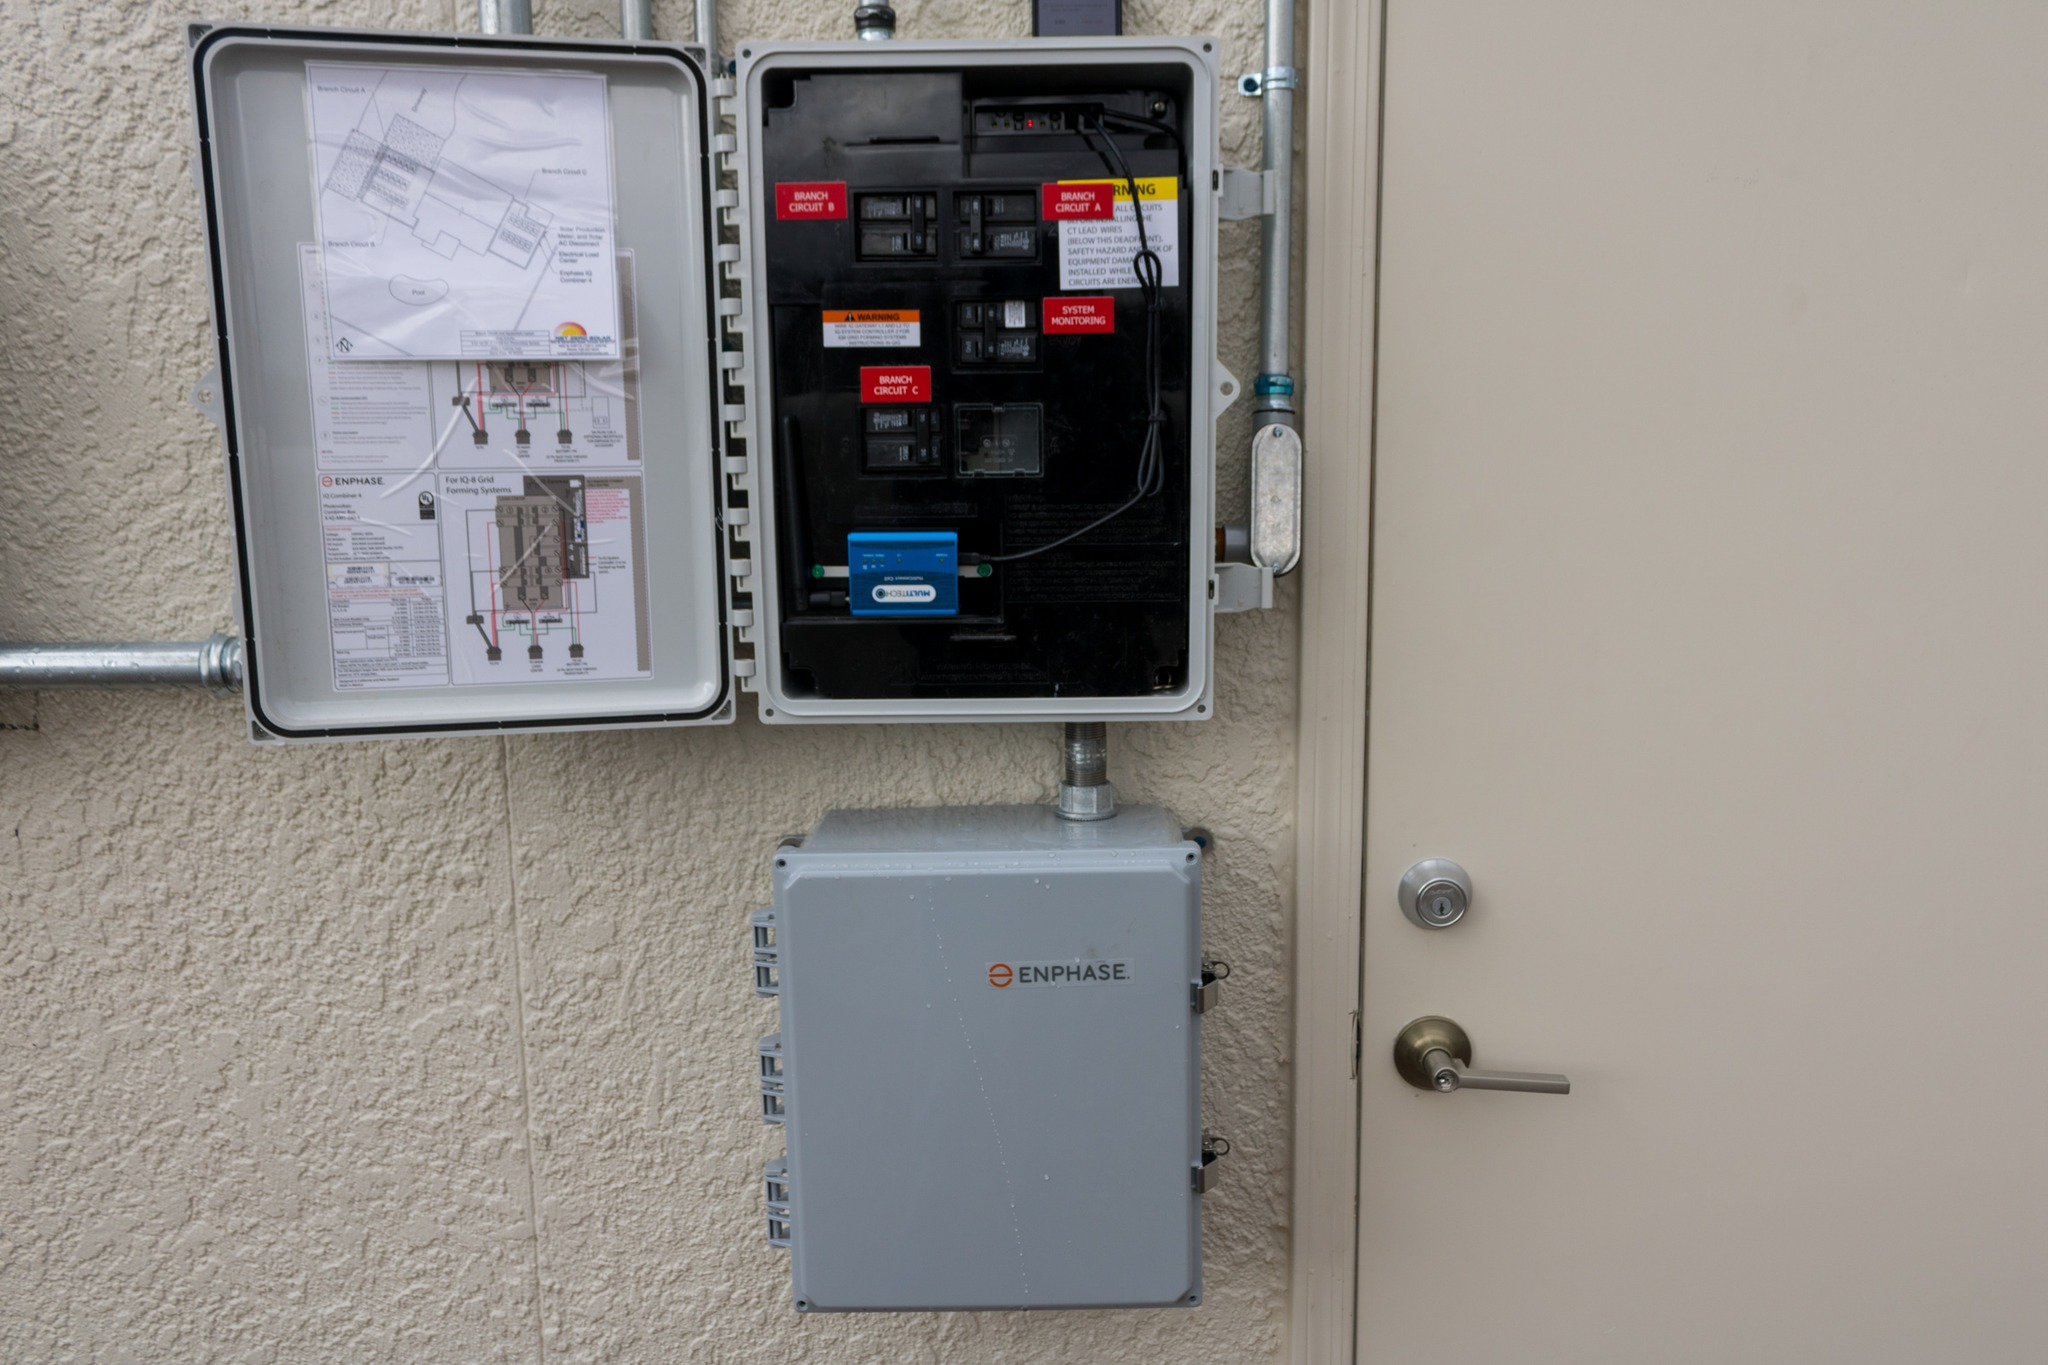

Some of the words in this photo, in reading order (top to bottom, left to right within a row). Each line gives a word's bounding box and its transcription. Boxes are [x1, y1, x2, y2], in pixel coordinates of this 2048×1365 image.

[794, 191, 828, 201] BRANCH
[1061, 192, 1095, 201] BRANCH
[789, 202, 823, 212] CIRCUIT
[828, 202, 835, 212] B
[1055, 203, 1090, 213] CIRCUIT
[1095, 203, 1102, 212] A
[1115, 204, 1129, 212] ALL
[1067, 227, 1076, 235] CT
[1079, 226, 1098, 234] LEAD
[1100, 225, 1122, 234] WIRES
[328, 240, 350, 248] Branch
[1096, 236, 1113, 245] THIS
[1068, 246, 1095, 256] SAFETY
[1096, 246, 1127, 255] HAZARD
[1162, 244, 1173, 252] OF
[1068, 256, 1111, 266] EQUIPMENT
[1068, 267, 1107, 276] INSTALLED
[1109, 266, 1132, 275] WHILE
[1068, 277, 1101, 286] CIRCUITS
[1102, 277, 1116, 285] ARE
[1062, 305, 1095, 315] SYSTEM
[857, 313, 900, 321] WARNING
[1051, 315, 1106, 326] MONITORING
[879, 375, 913, 384] BRANCH
[873, 386, 908, 396] CIRCUIT
[912, 385, 919, 395] C
[445, 476, 458, 484] For
[459, 475, 477, 484] IQ-8
[477, 475, 495, 483] Grid
[446, 487, 479, 496] Forming
[480, 487, 512, 495] Systems
[886, 589, 931, 598] MULTITECH
